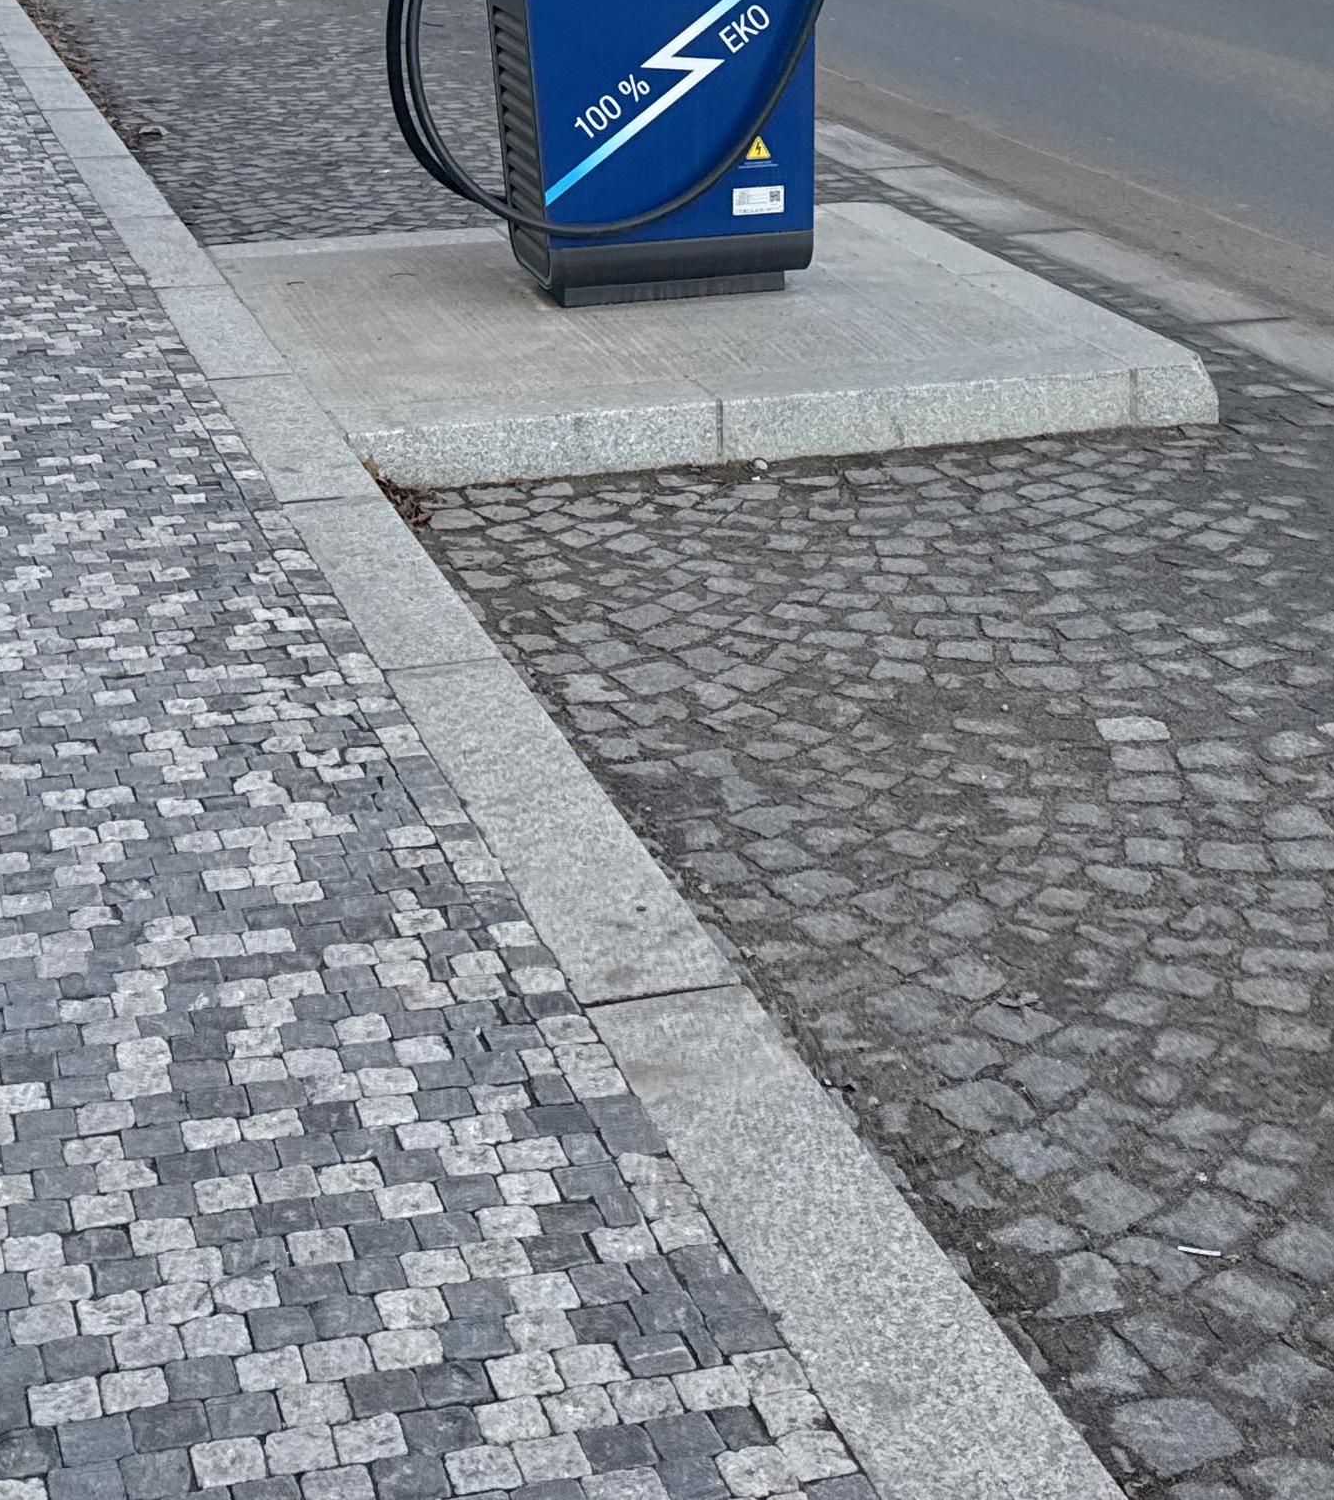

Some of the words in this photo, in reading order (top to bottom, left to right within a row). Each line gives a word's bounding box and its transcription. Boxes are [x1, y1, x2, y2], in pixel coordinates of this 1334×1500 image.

[574, 95, 622, 139] 100
[618, 74, 651, 102] %
[718, 4, 771, 54] EKO
